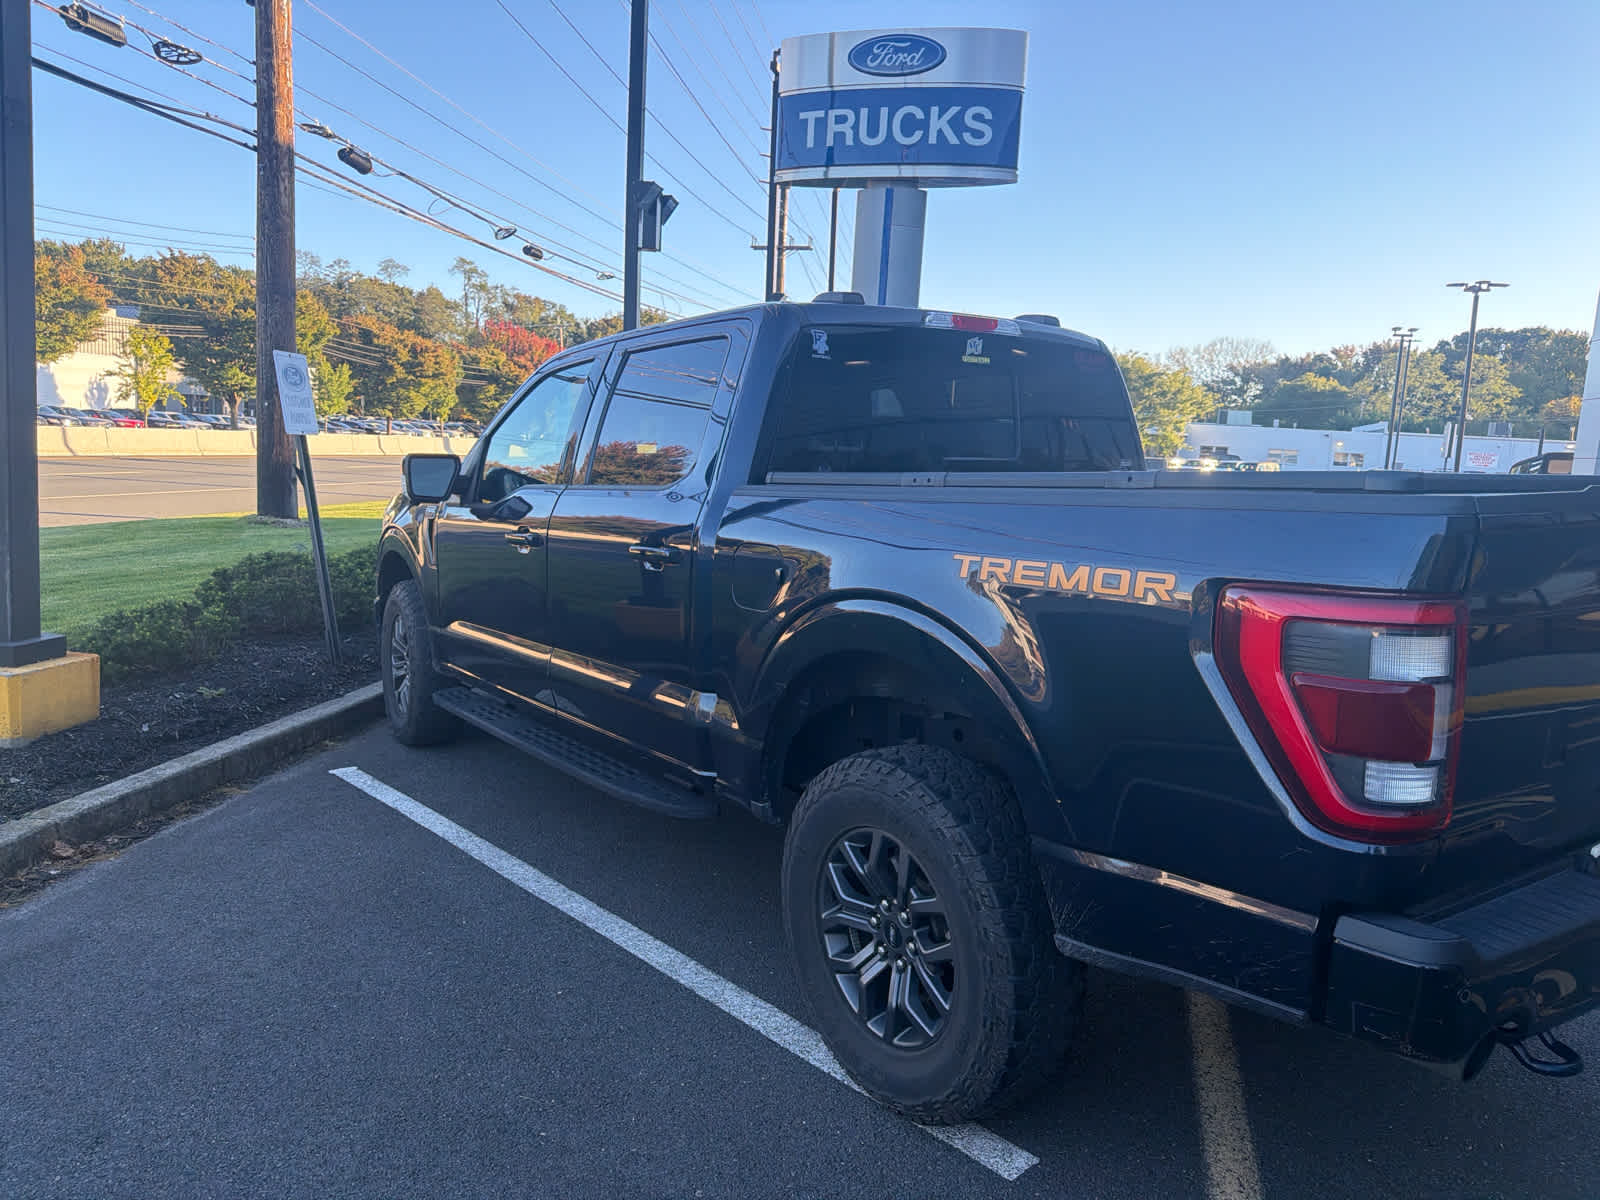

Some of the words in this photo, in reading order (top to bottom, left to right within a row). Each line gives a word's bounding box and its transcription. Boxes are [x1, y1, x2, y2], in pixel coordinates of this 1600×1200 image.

[866, 41, 925, 67] Ford
[799, 105, 993, 149] TRUCKS
[953, 553, 1176, 602] TREMOR
